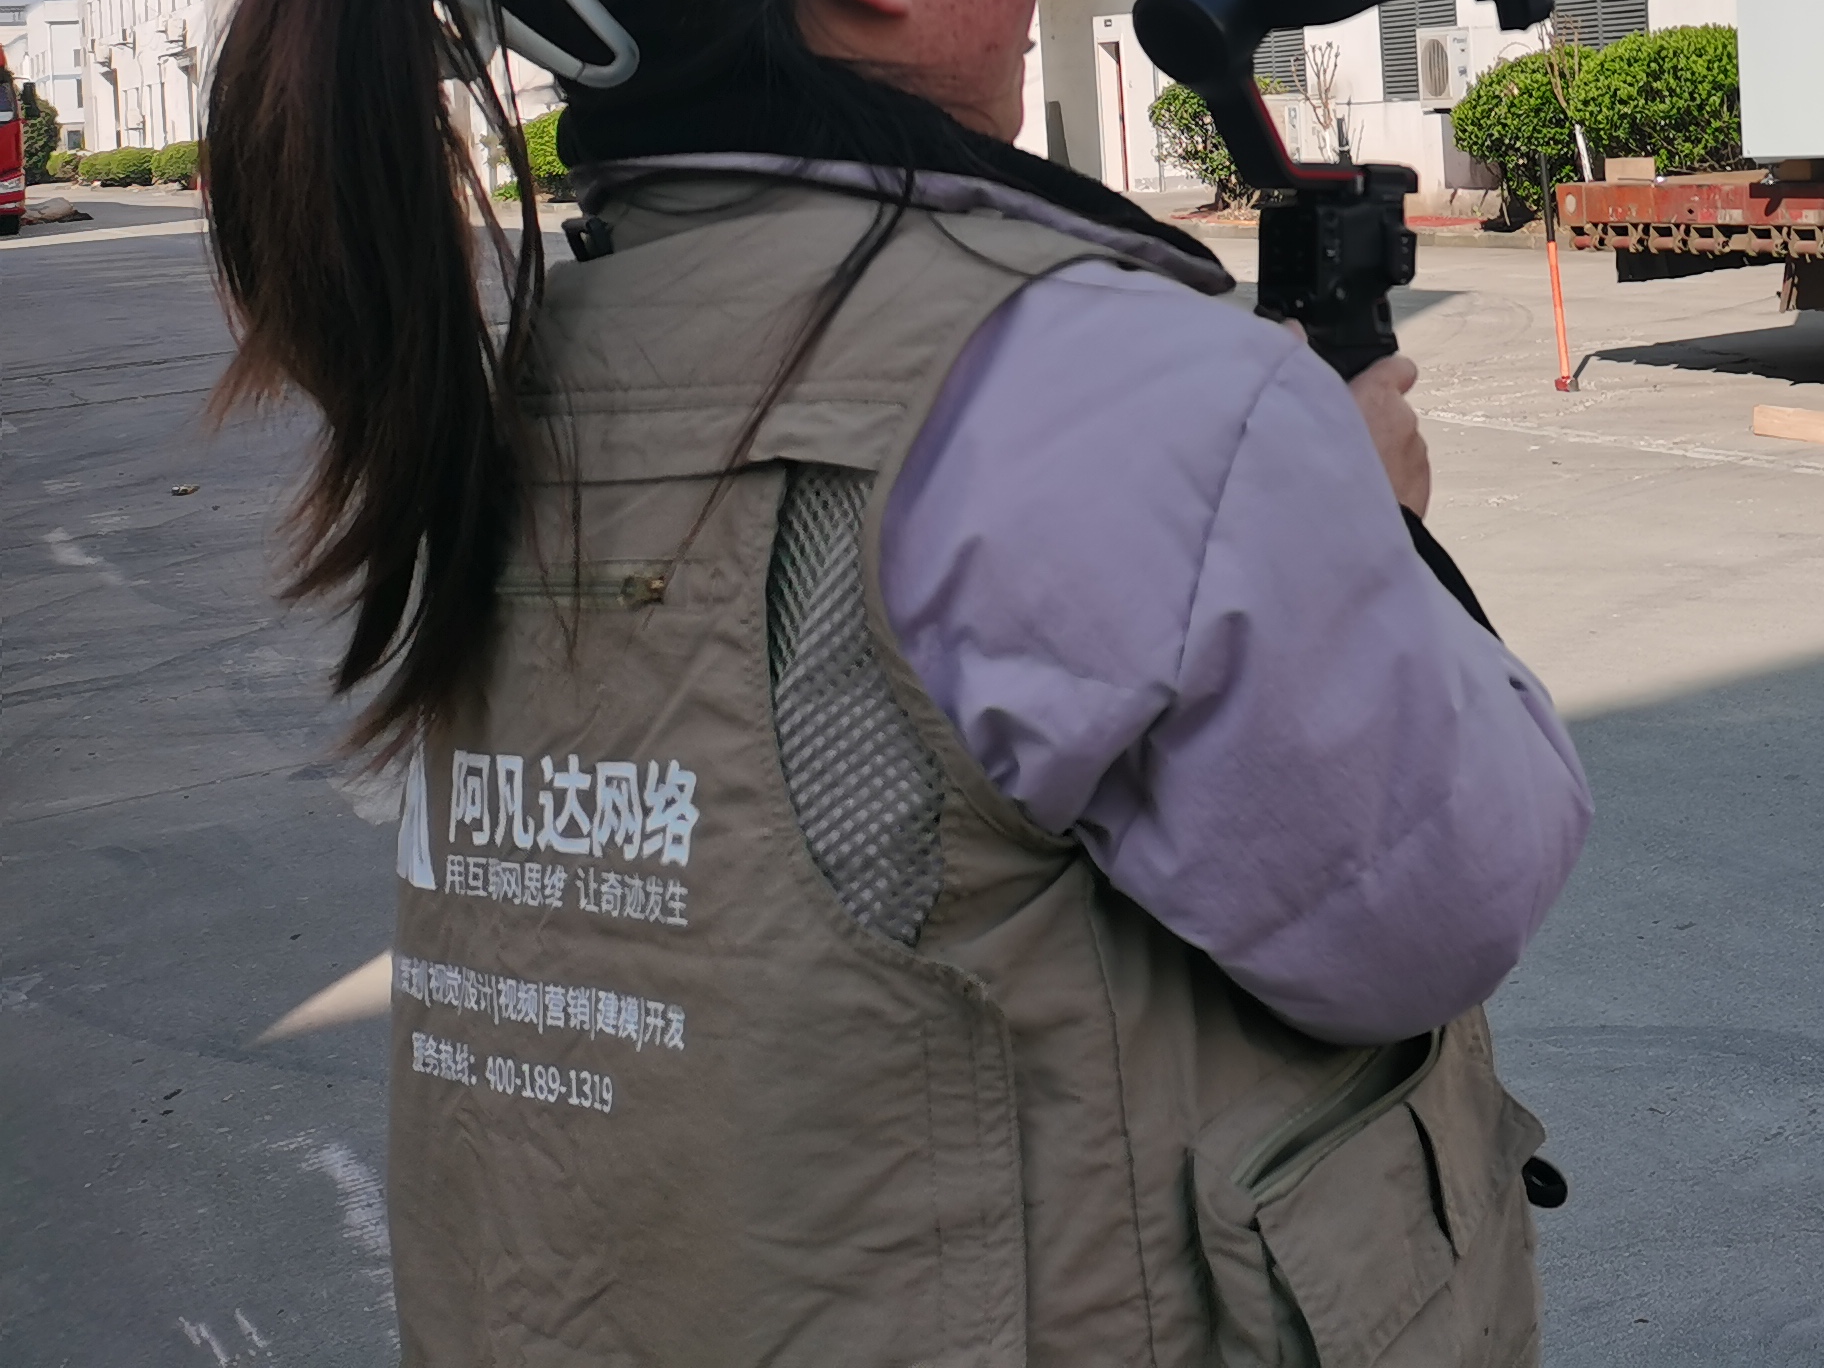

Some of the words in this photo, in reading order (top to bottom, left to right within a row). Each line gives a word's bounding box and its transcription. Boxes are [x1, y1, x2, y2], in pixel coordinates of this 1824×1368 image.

[449, 749, 699, 867] 阿凡达网络
[444, 854, 568, 909] 用互联网思维
[575, 866, 689, 927] 让奇迹发生
